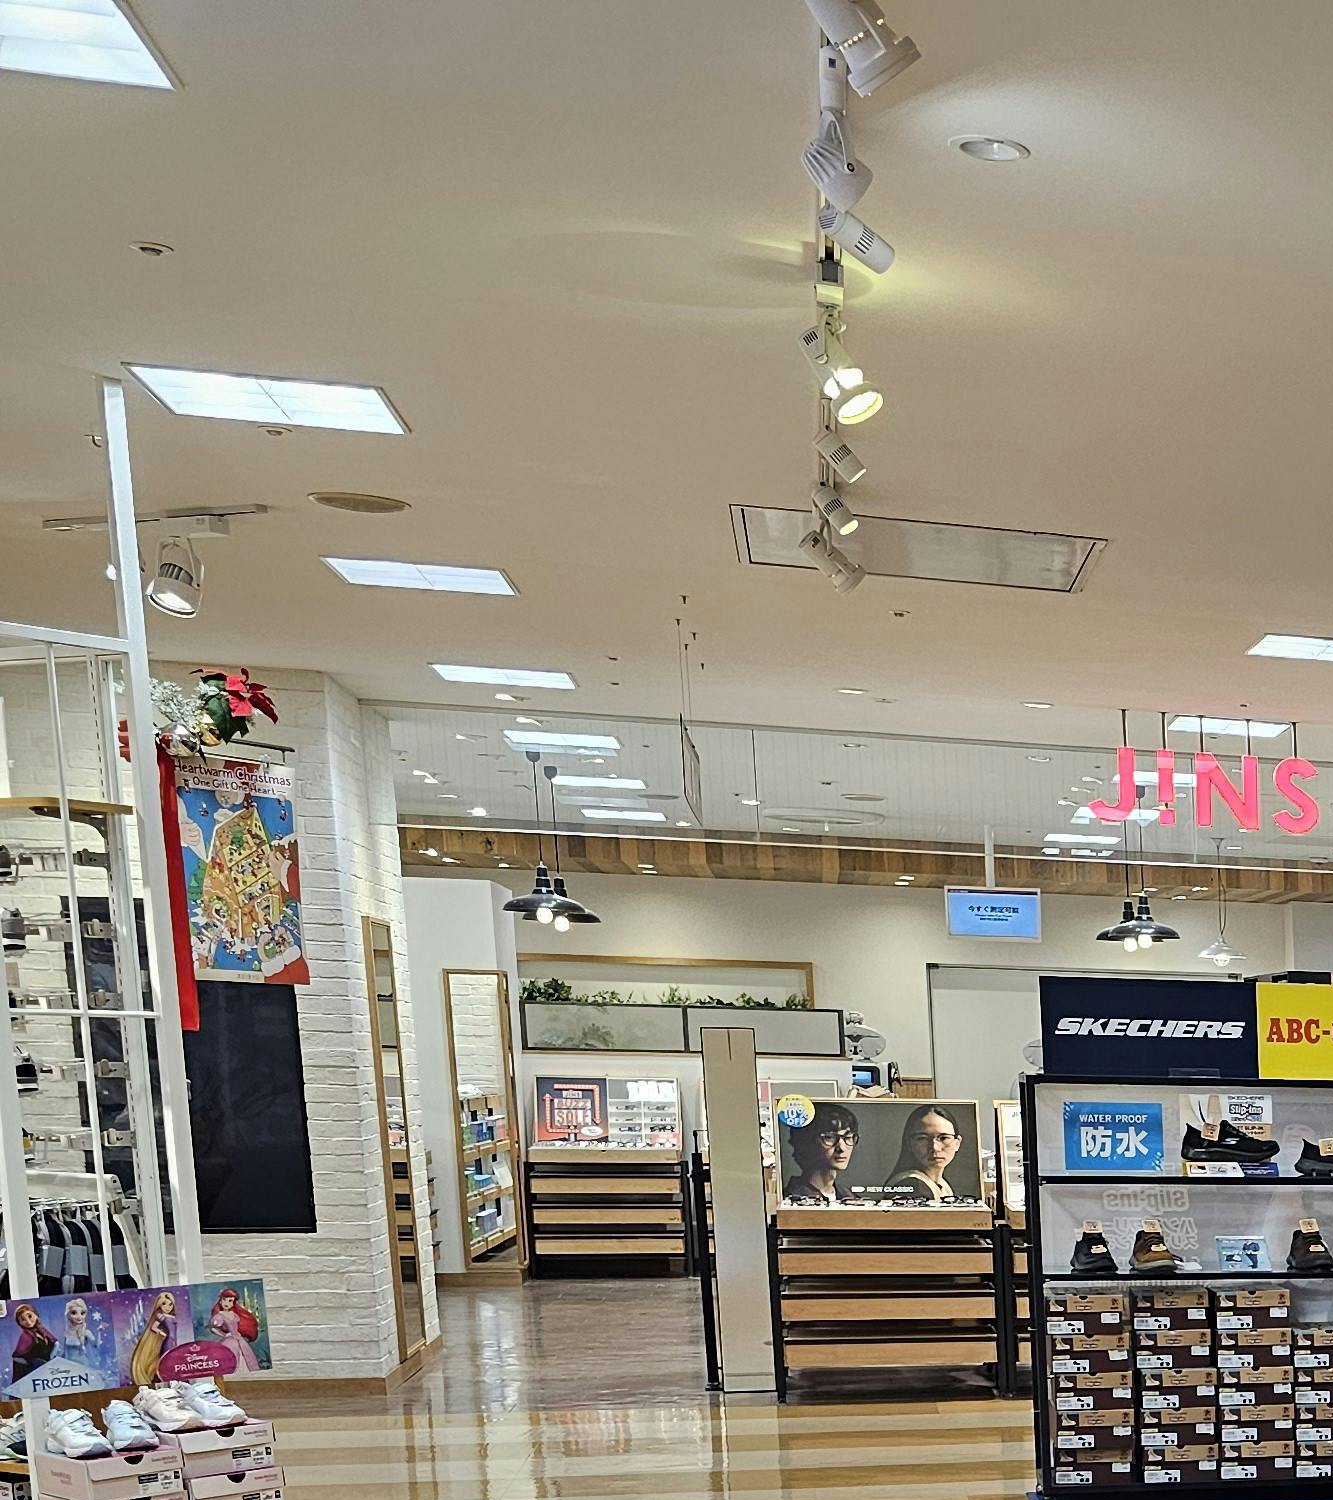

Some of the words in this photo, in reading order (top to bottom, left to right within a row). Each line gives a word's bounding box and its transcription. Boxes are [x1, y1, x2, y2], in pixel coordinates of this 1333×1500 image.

[175, 762, 232, 779] Heartwarm
[235, 768, 291, 786] Christmas
[193, 776, 210, 786] One
[213, 780, 229, 789] Gift
[251, 785, 275, 795] Heart
[1054, 1016, 1246, 1040] SKECHERS
[1079, 1113, 1113, 1124] WATER
[1116, 1113, 1148, 1124] PROOF
[1080, 1127, 1150, 1159] 防水
[174, 1359, 220, 1372] PRINCESS
[32, 1373, 89, 1393] FROZEN
